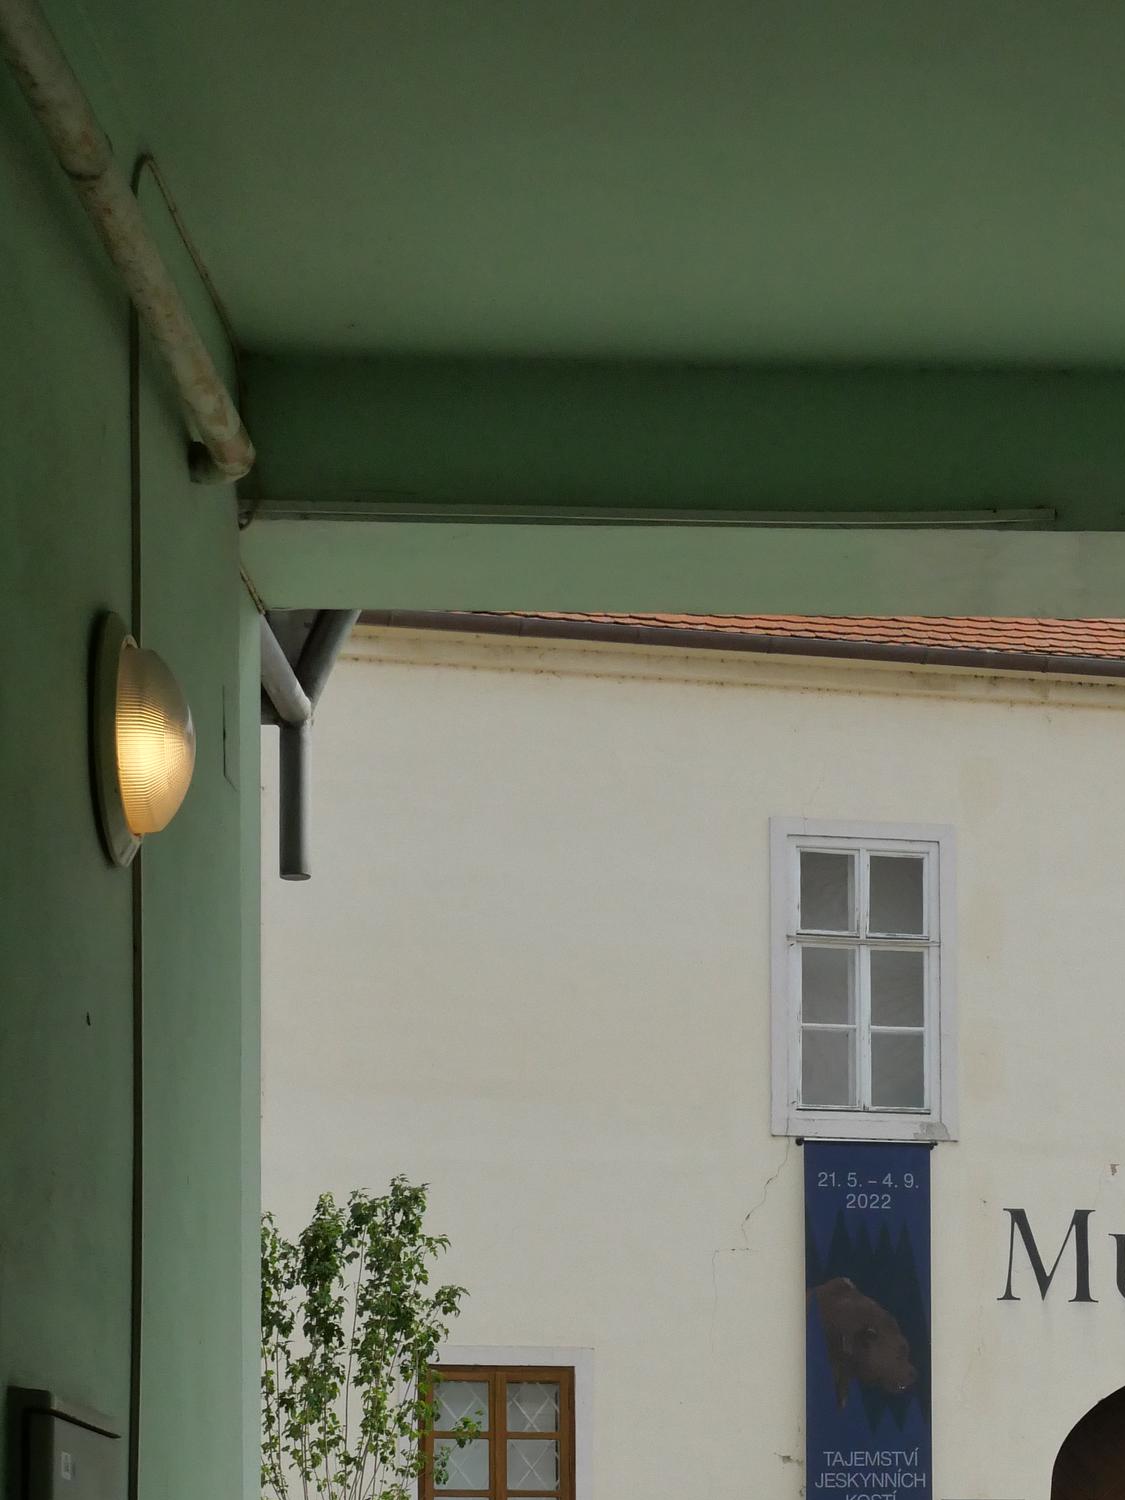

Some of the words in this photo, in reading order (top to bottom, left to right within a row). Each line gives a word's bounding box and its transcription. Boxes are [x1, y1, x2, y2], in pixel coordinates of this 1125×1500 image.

[817, 1171, 841, 1187] 21.
[847, 1172, 862, 1188] 5.
[882, 1172, 898, 1188] 4.
[904, 1173, 919, 1189] 9.
[846, 1193, 891, 1209] 2022
[823, 1447, 919, 1467] TAJEMSTVÍ
[814, 1468, 926, 1488] JESKYNNÍCH
